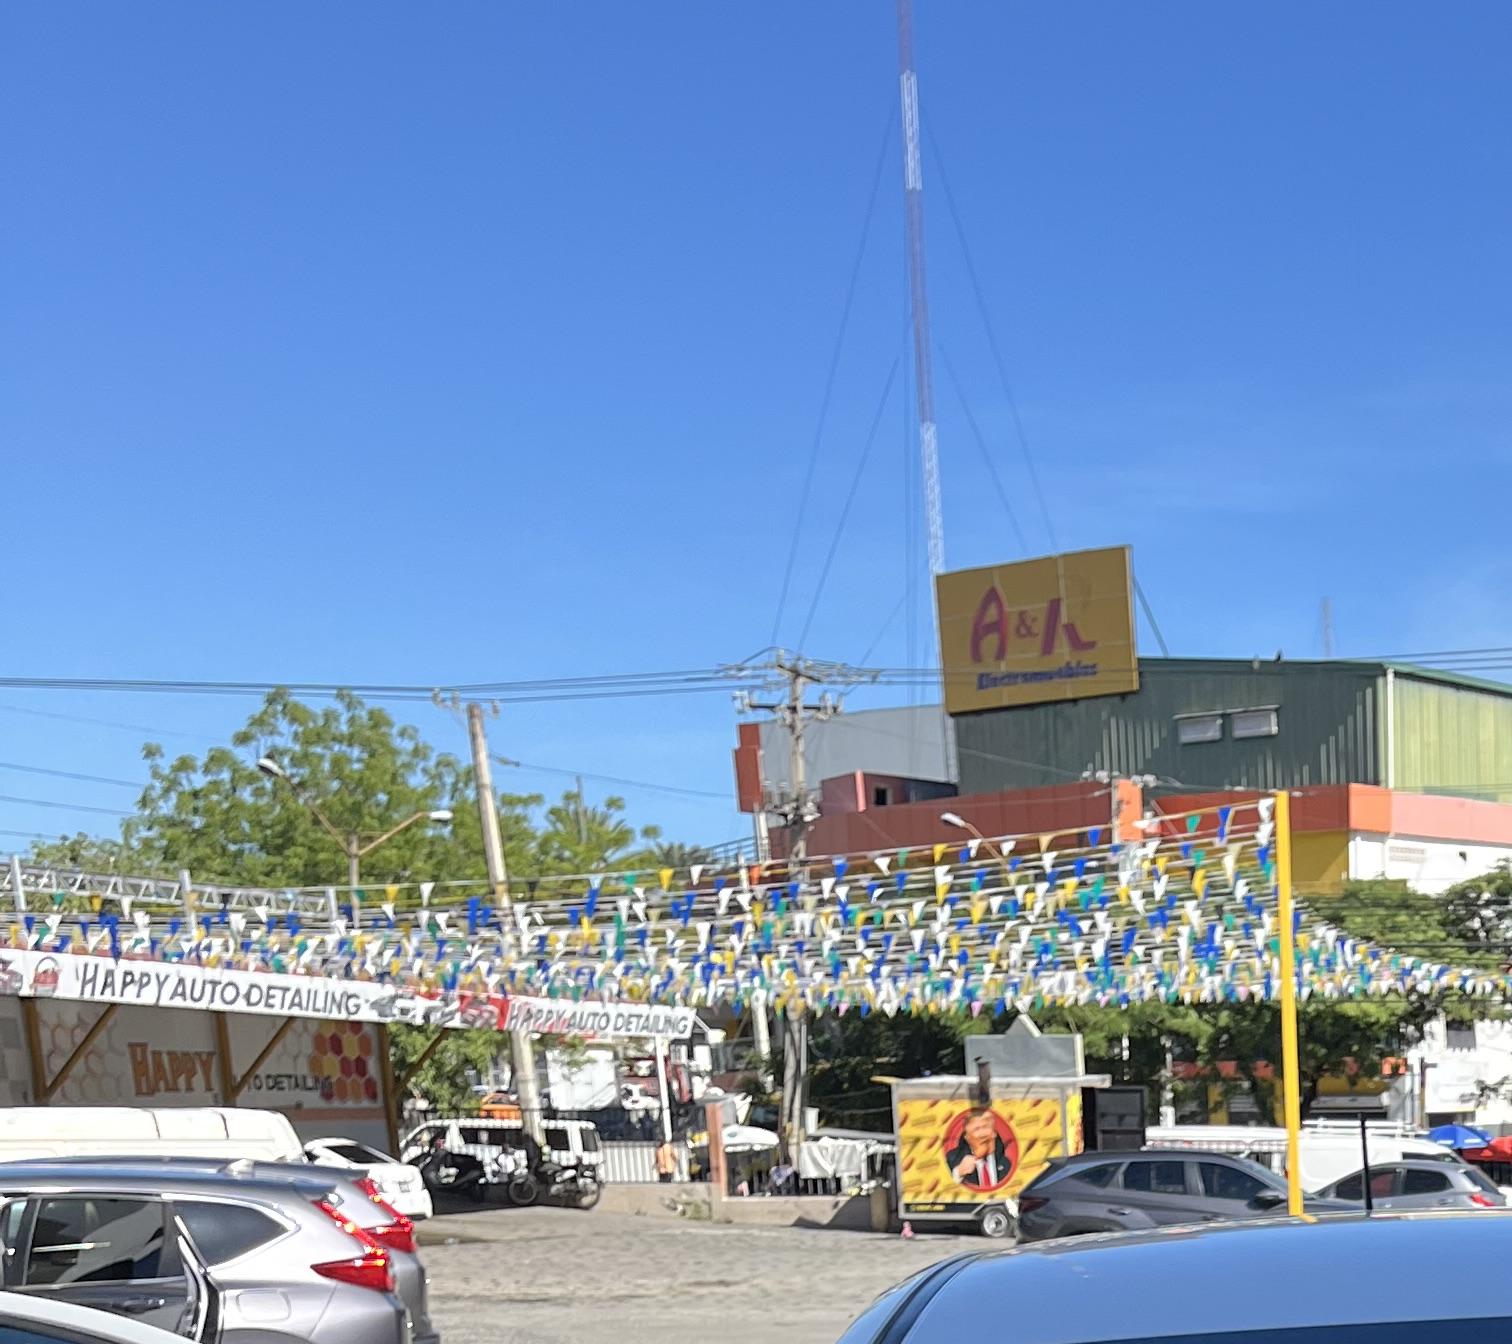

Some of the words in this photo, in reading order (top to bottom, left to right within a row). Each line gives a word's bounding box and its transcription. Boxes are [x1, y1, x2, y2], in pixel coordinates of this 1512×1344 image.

[970, 585, 1008, 663] A
[1015, 610, 1040, 638] &
[79, 963, 170, 1006] HAPPY
[170, 979, 242, 1006] AUTO
[243, 983, 362, 1016] DETAILING
[507, 1002, 566, 1032] HAPPY
[568, 1008, 610, 1032] AUTO
[614, 1011, 691, 1034] DETAILING
[127, 1042, 217, 1097] HAPPY
